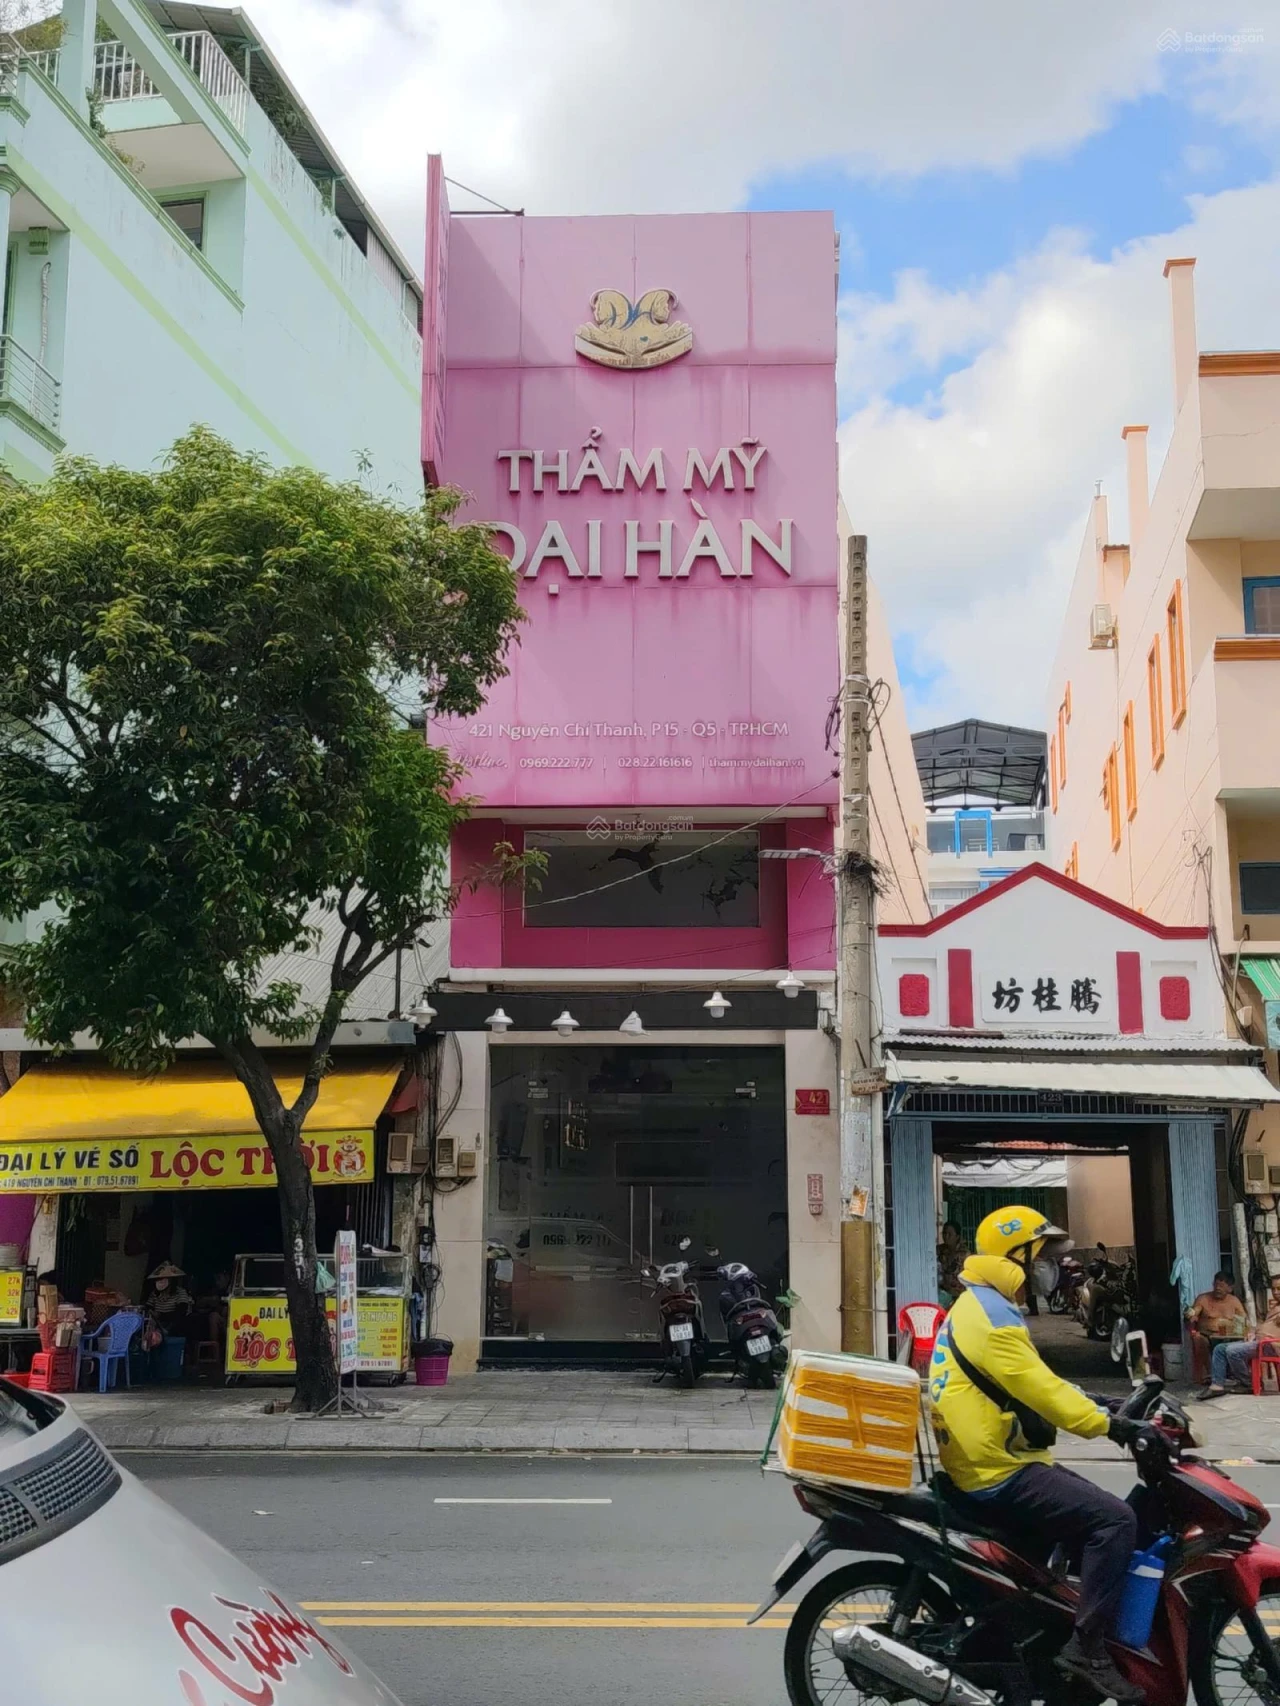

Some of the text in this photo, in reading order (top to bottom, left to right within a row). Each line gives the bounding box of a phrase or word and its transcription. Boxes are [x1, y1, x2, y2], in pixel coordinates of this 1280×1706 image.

[497, 426, 768, 492] THẨM MỸ
[624, 497, 794, 578] HÀN
[469, 723, 493, 737] 421
[564, 721, 590, 738] Chí
[595, 722, 647, 739] Thanh,
[692, 722, 717, 738] Q5
[519, 757, 594, 769] 0969.222.777
[617, 756, 693, 768] 028.22.161616
[40, 1147, 67, 1171] LÝ
[74, 1146, 101, 1169] VÉ
[108, 1142, 140, 1169] SỐ
[150, 1140, 225, 1186] LỘC
[232, 1332, 281, 1369] LỘC
